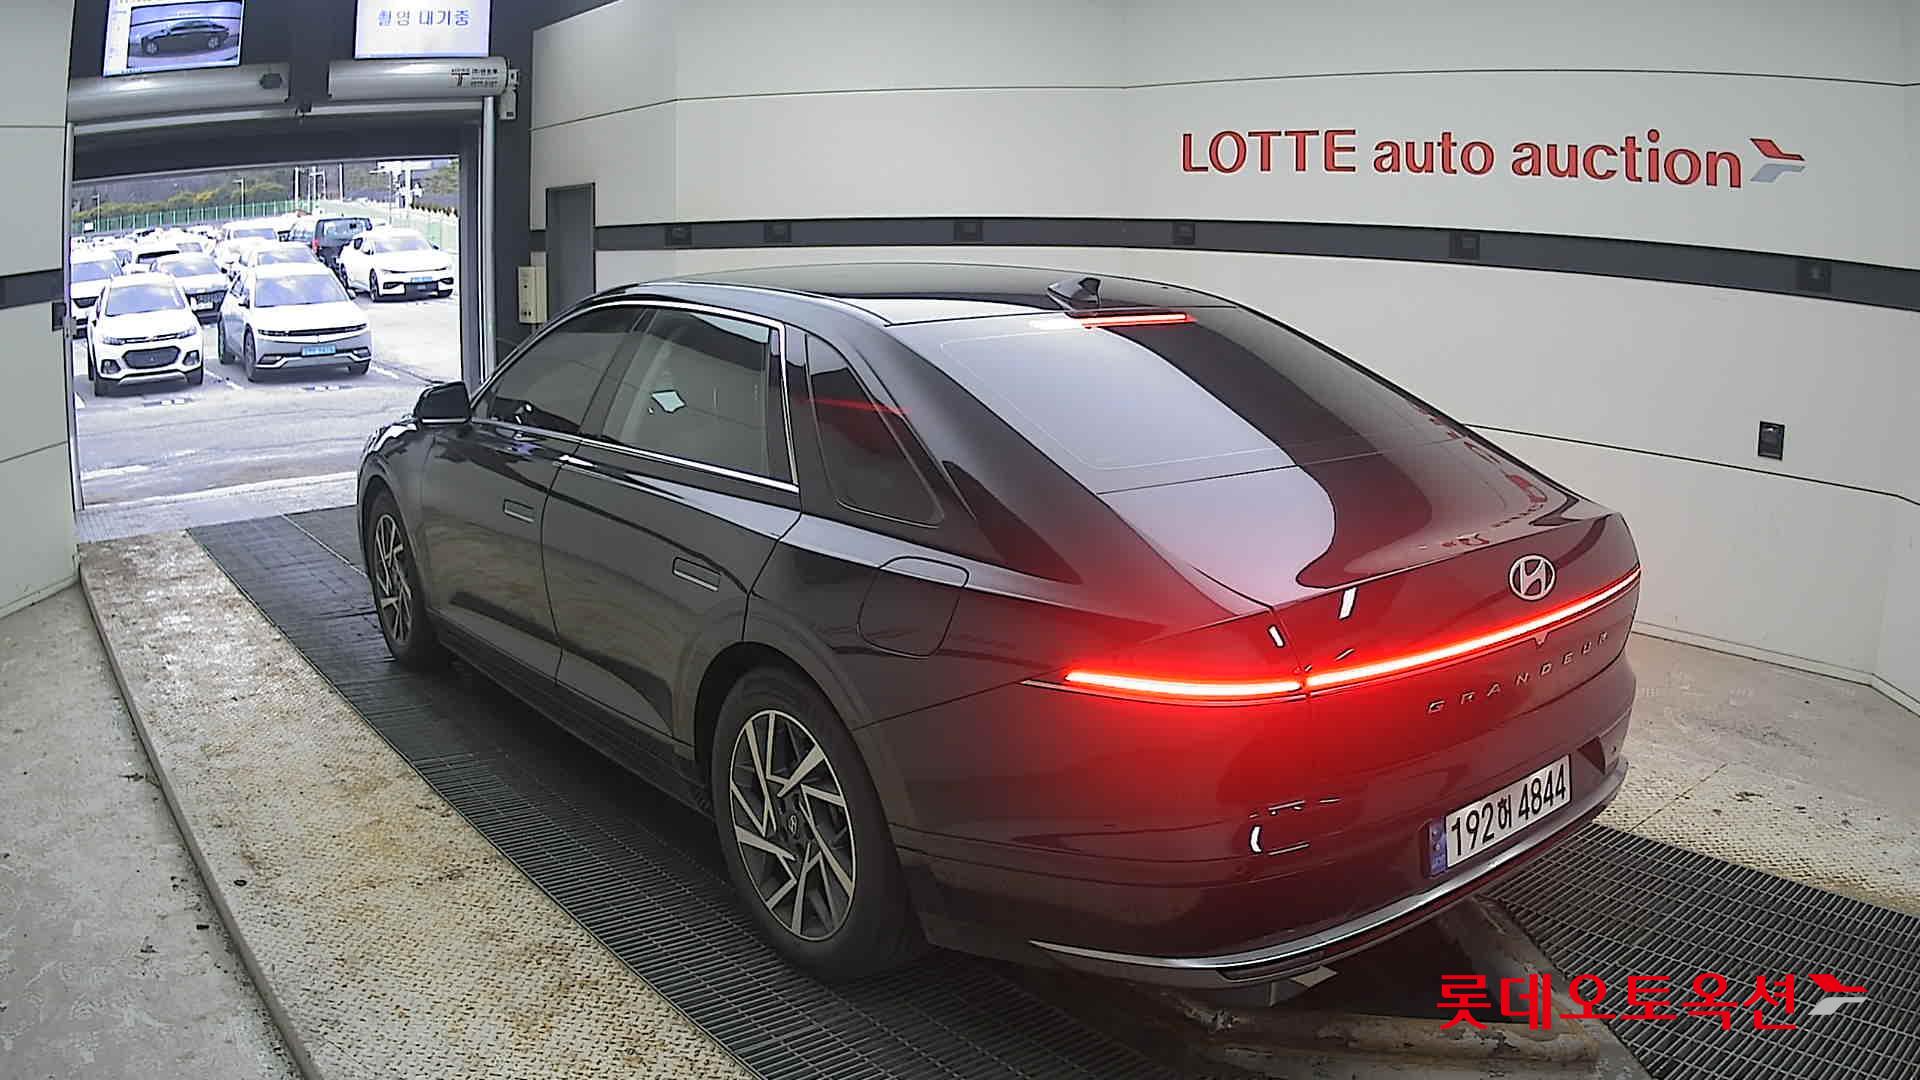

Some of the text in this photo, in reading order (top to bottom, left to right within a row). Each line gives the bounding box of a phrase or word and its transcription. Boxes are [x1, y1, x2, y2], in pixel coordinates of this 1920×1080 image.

[1182, 128, 1743, 189] LOTTE auto auction
[1427, 631, 1608, 714] GRANDEUR
[1518, 764, 1567, 821] 4844
